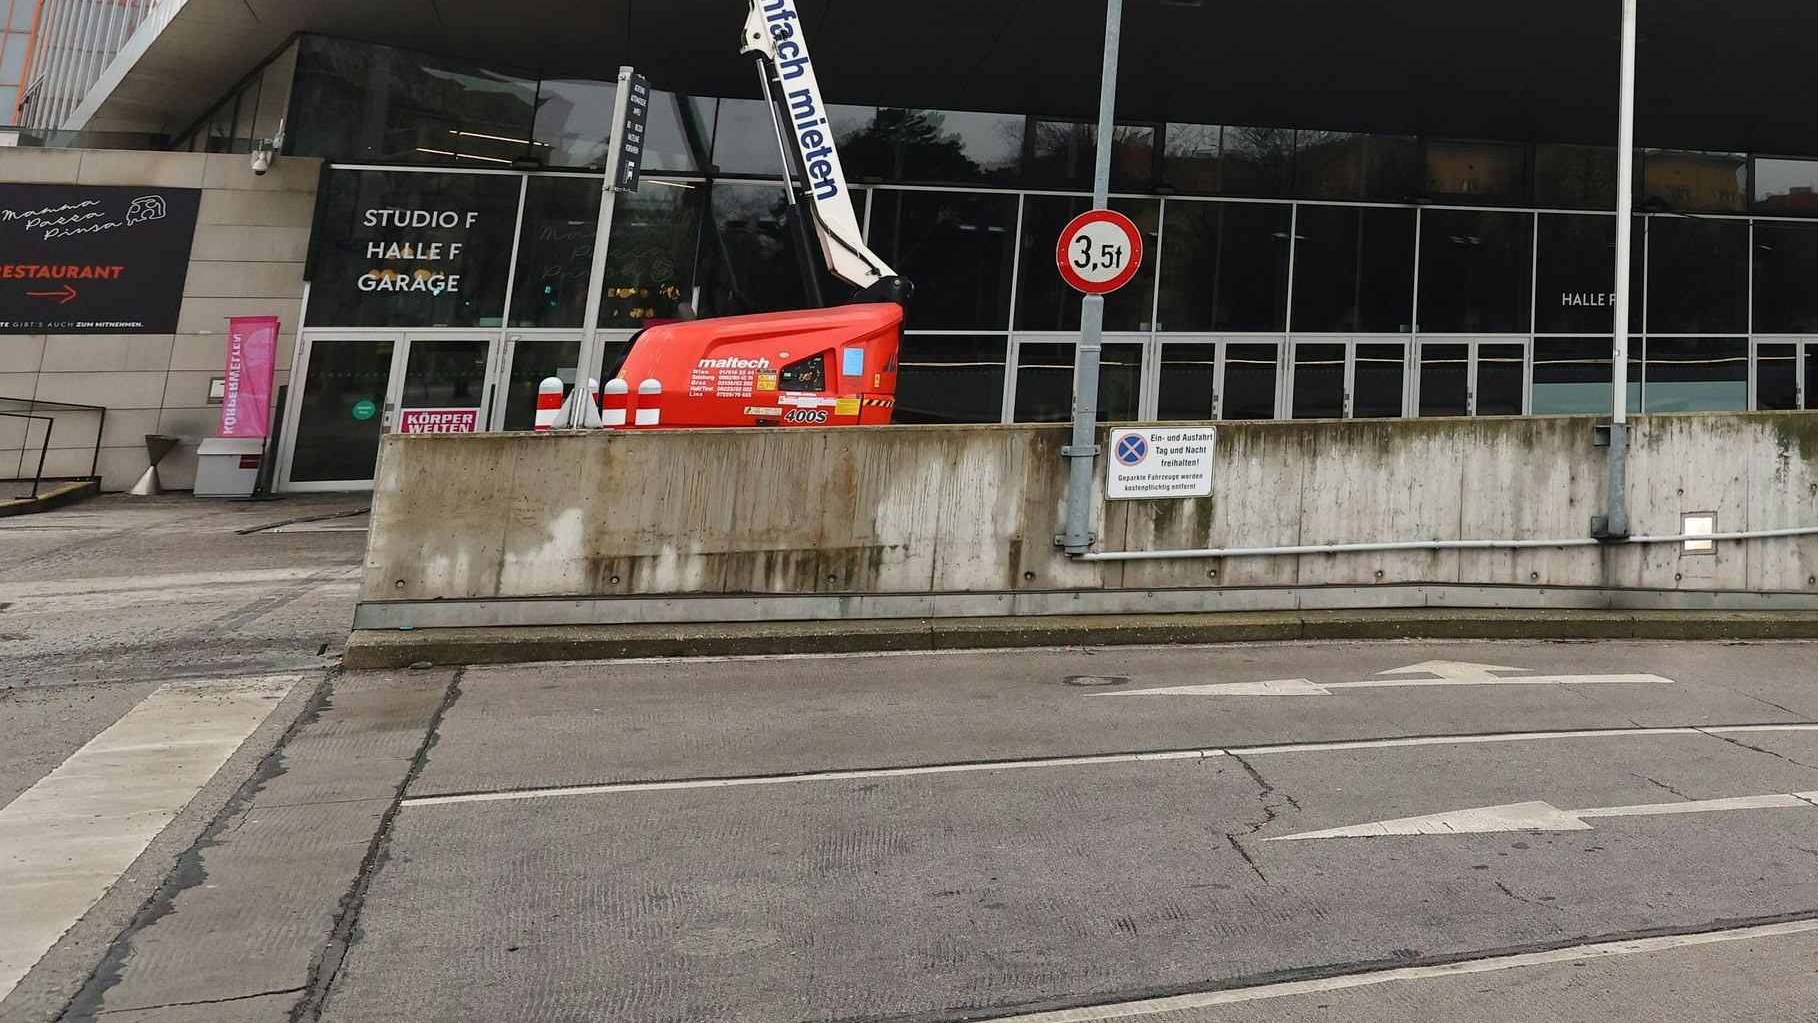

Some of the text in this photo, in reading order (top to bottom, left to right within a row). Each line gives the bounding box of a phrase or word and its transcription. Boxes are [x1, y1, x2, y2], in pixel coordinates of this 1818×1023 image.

[788, 92, 838, 201] mieten
[2, 200, 100, 221] Mamma
[364, 209, 478, 228] STUDIO F
[366, 242, 462, 260] HALLE F
[1073, 235, 1122, 271] 3,5t
[358, 274, 460, 292] GARAGE
[1562, 293, 1605, 306] HALLE
[698, 356, 769, 368] maltech
[407, 412, 473, 424] KÖRPER
[784, 410, 827, 423] 400S
[408, 424, 470, 434] WELTEN
[1150, 434, 1165, 442] Ein-
[1182, 433, 1213, 441] Ausfahrt
[1156, 447, 1168, 455] Tag
[1185, 446, 1207, 454] Nacht
[1161, 459, 1199, 467] freihalten!
[1118, 474, 1146, 482] Geparkte
